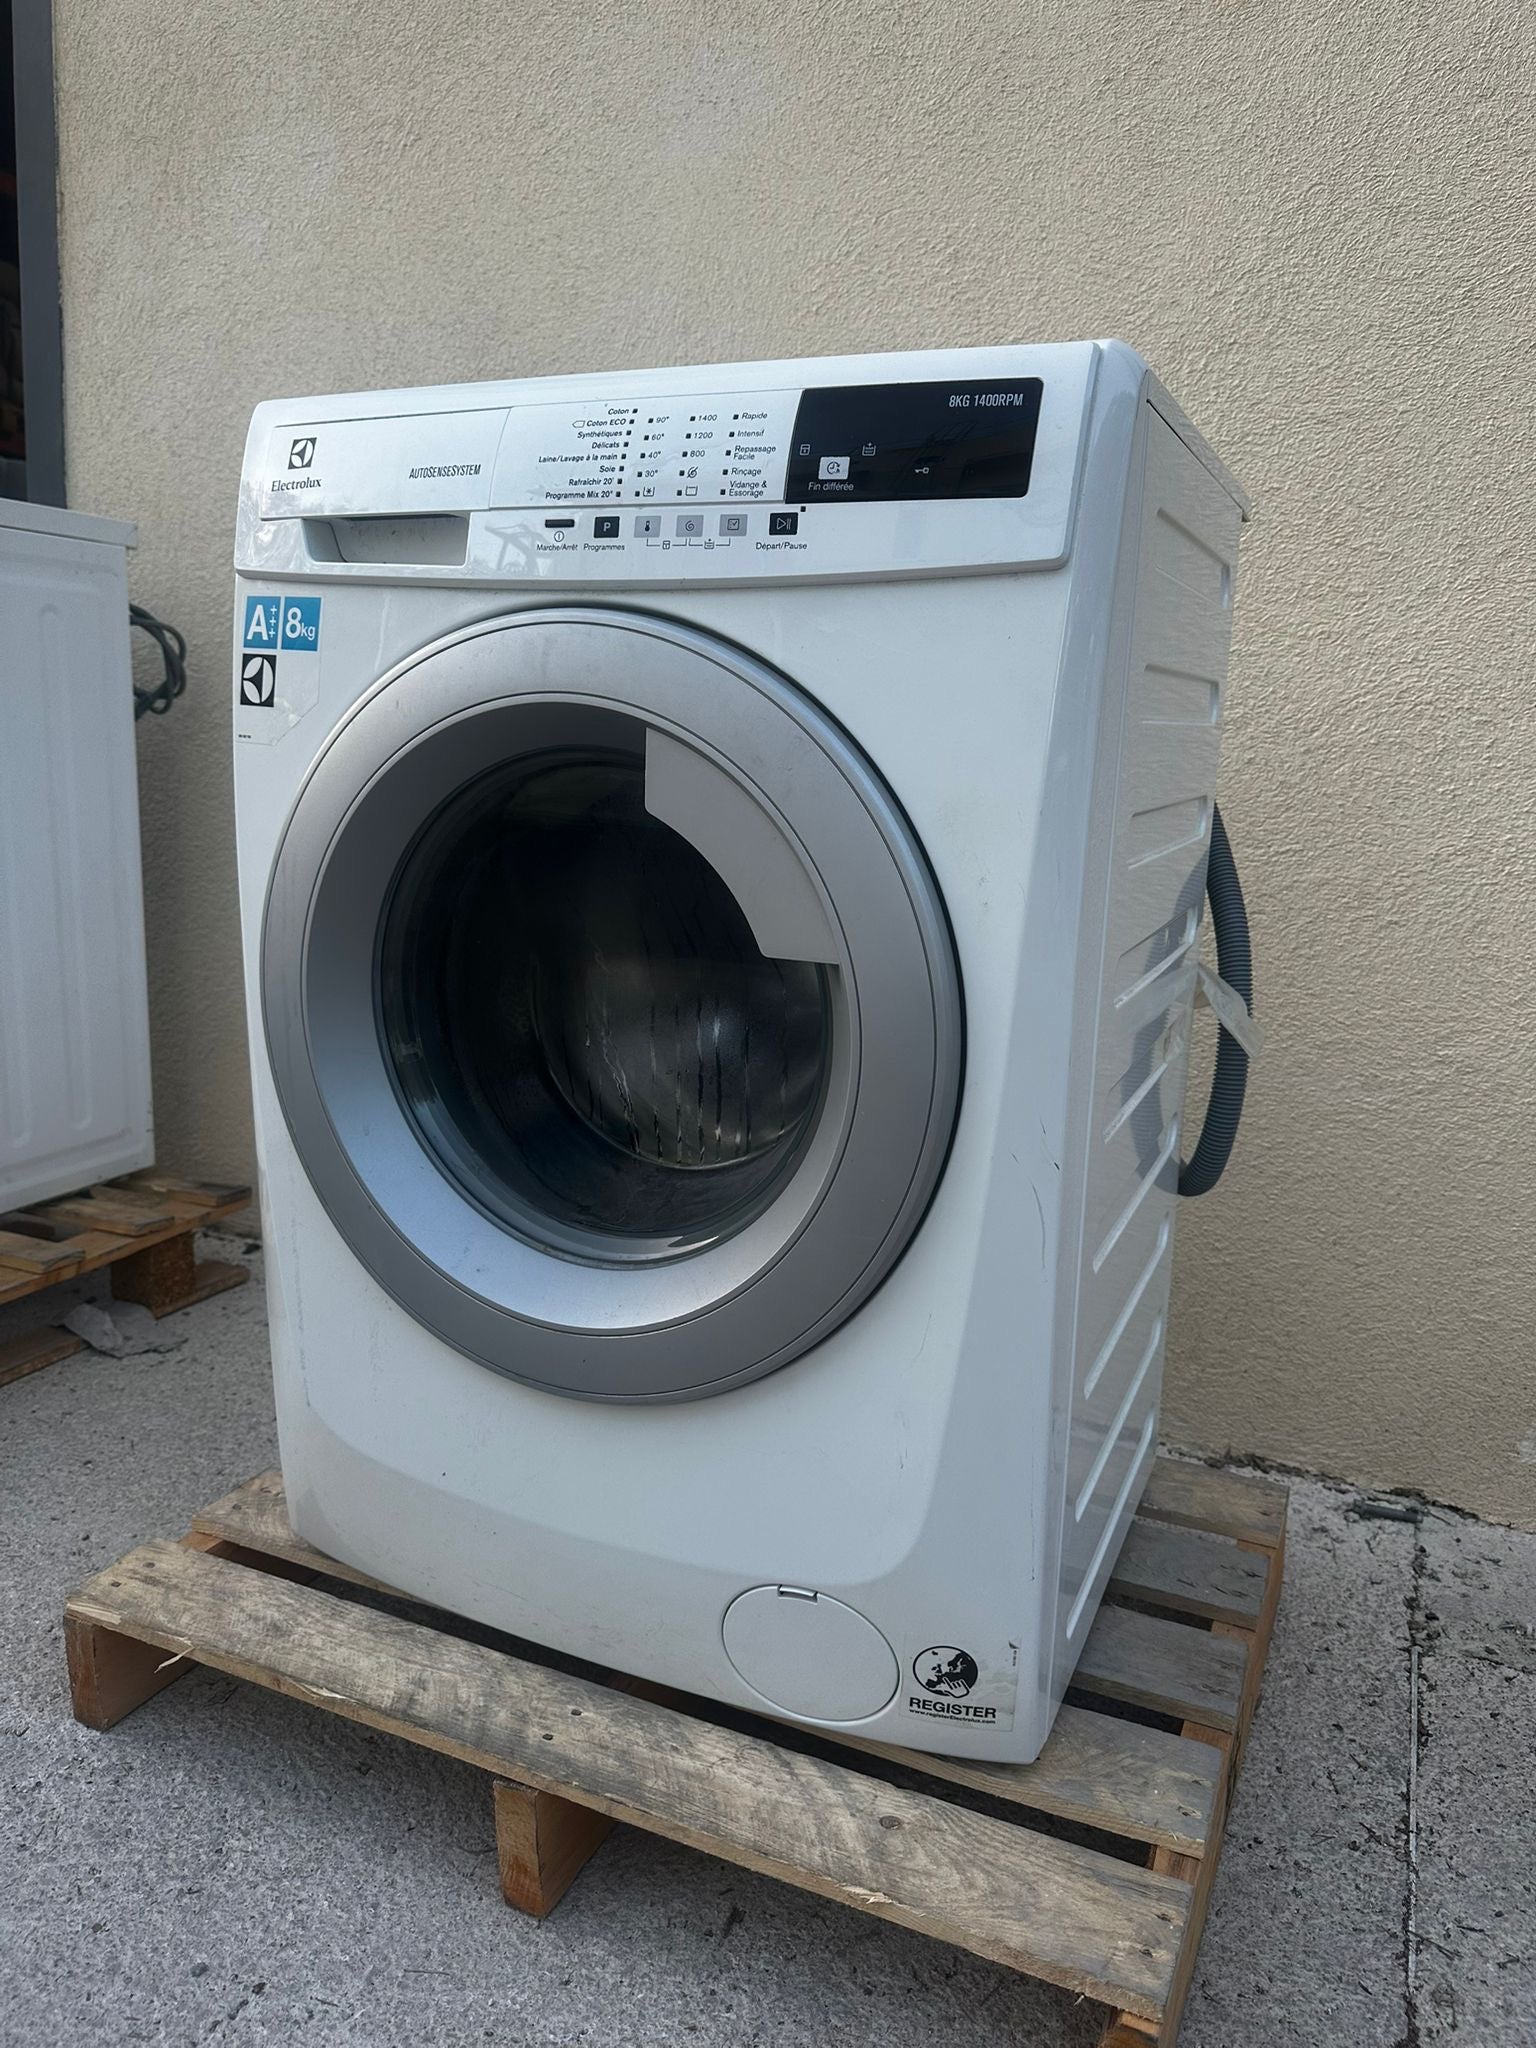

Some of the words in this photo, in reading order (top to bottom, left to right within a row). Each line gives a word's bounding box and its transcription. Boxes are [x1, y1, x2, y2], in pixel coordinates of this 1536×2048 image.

[949, 394, 970, 407] 8KG
[974, 393, 1024, 407] 1400RPM
[741, 412, 768, 421] Rapide
[609, 418, 627, 426] ECO
[577, 430, 623, 440] Synthétiques
[694, 431, 713, 439] 1200
[737, 429, 765, 437] Intensif
[591, 441, 620, 449] Délicats
[734, 445, 777, 454] Repassage
[538, 454, 585, 463] Laine/Lavage
[592, 453, 599, 461] la
[690, 450, 705, 458] 800
[599, 465, 616, 473] Soie
[731, 467, 762, 477] Rinçage
[271, 476, 322, 493] Electrolux
[568, 477, 602, 486] Rafraîchir
[729, 480, 760, 490] Vidange
[761, 480, 768, 488] &
[808, 482, 821, 491] Fin
[822, 481, 854, 492] différée
[545, 491, 585, 500] Programme
[587, 490, 599, 498] Mix
[729, 488, 764, 498] Essorage
[603, 522, 611, 532] P
[536, 543, 579, 551] Marche/Arrêt
[583, 543, 625, 552] Programmes
[755, 541, 808, 552] Départ/Pause
[285, 607, 316, 641] 8kg
[909, 1697, 997, 1719] REGISTER
